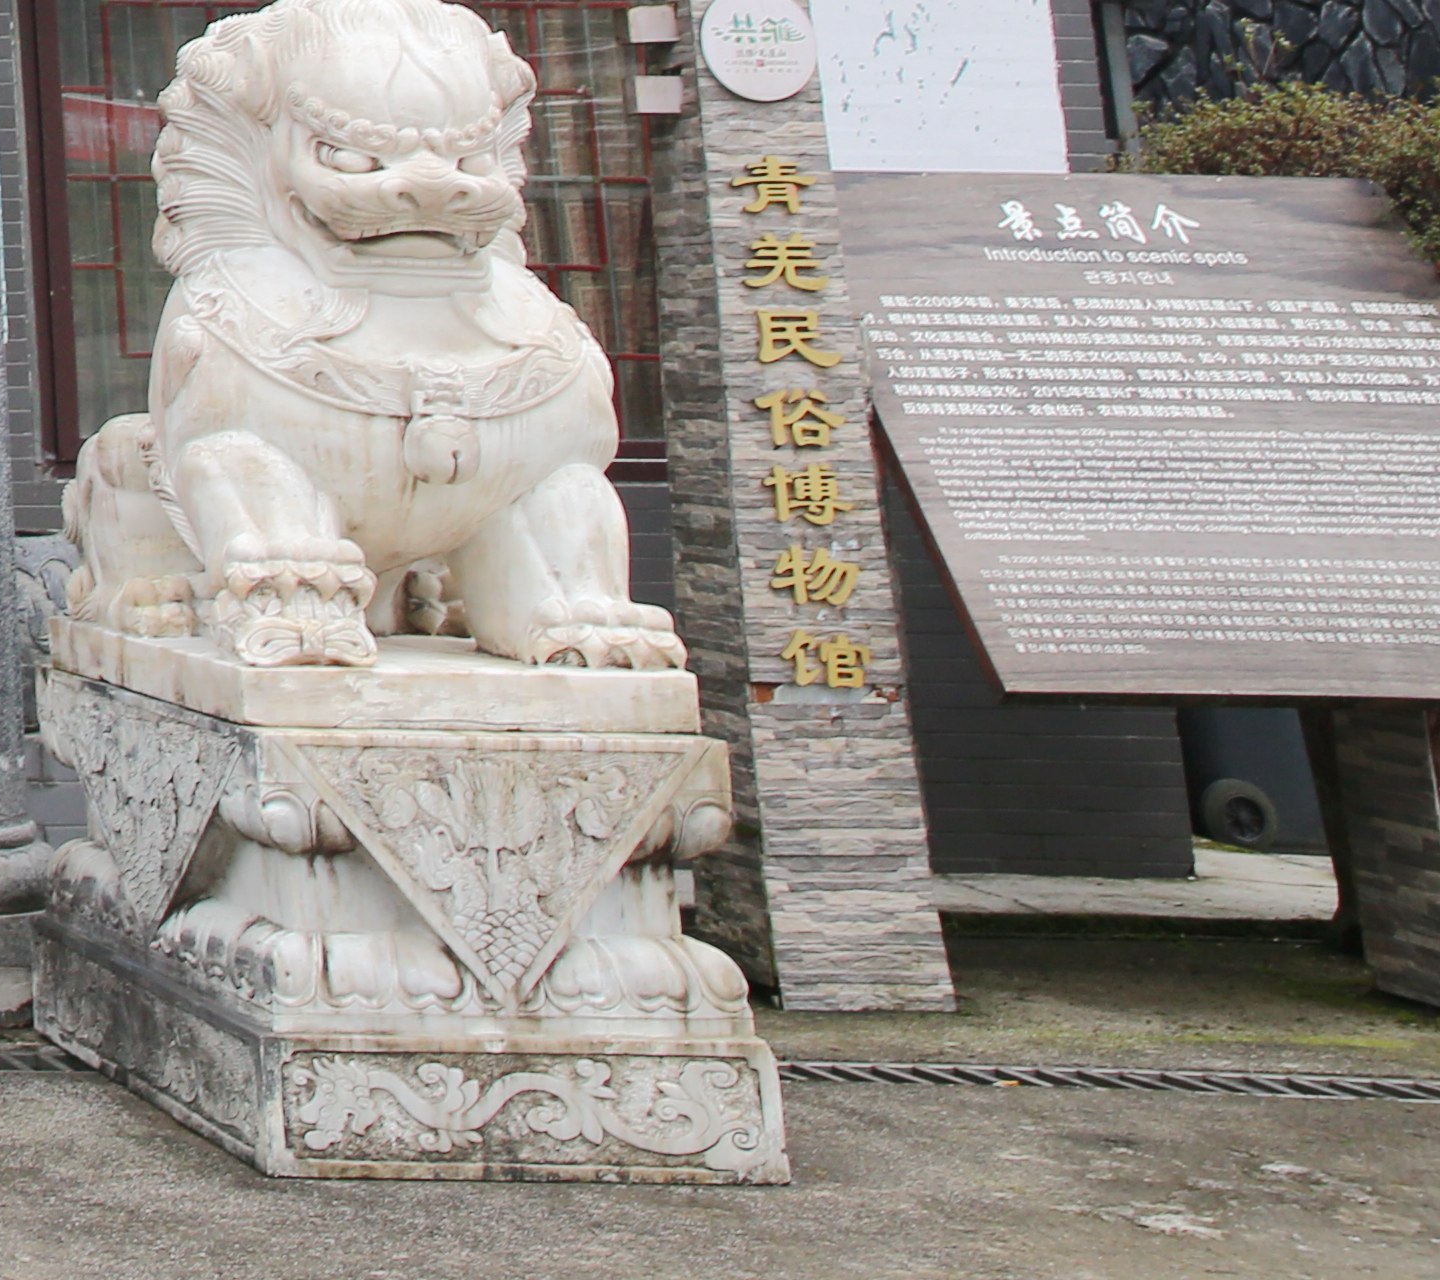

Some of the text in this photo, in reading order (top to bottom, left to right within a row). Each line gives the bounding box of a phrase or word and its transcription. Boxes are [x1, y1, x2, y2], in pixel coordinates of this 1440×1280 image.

[997, 199, 1201, 244] 景点简介
[984, 246, 1249, 268] Introduction to scenic spots
[731, 155, 872, 691] 青羌民俗博物馆
